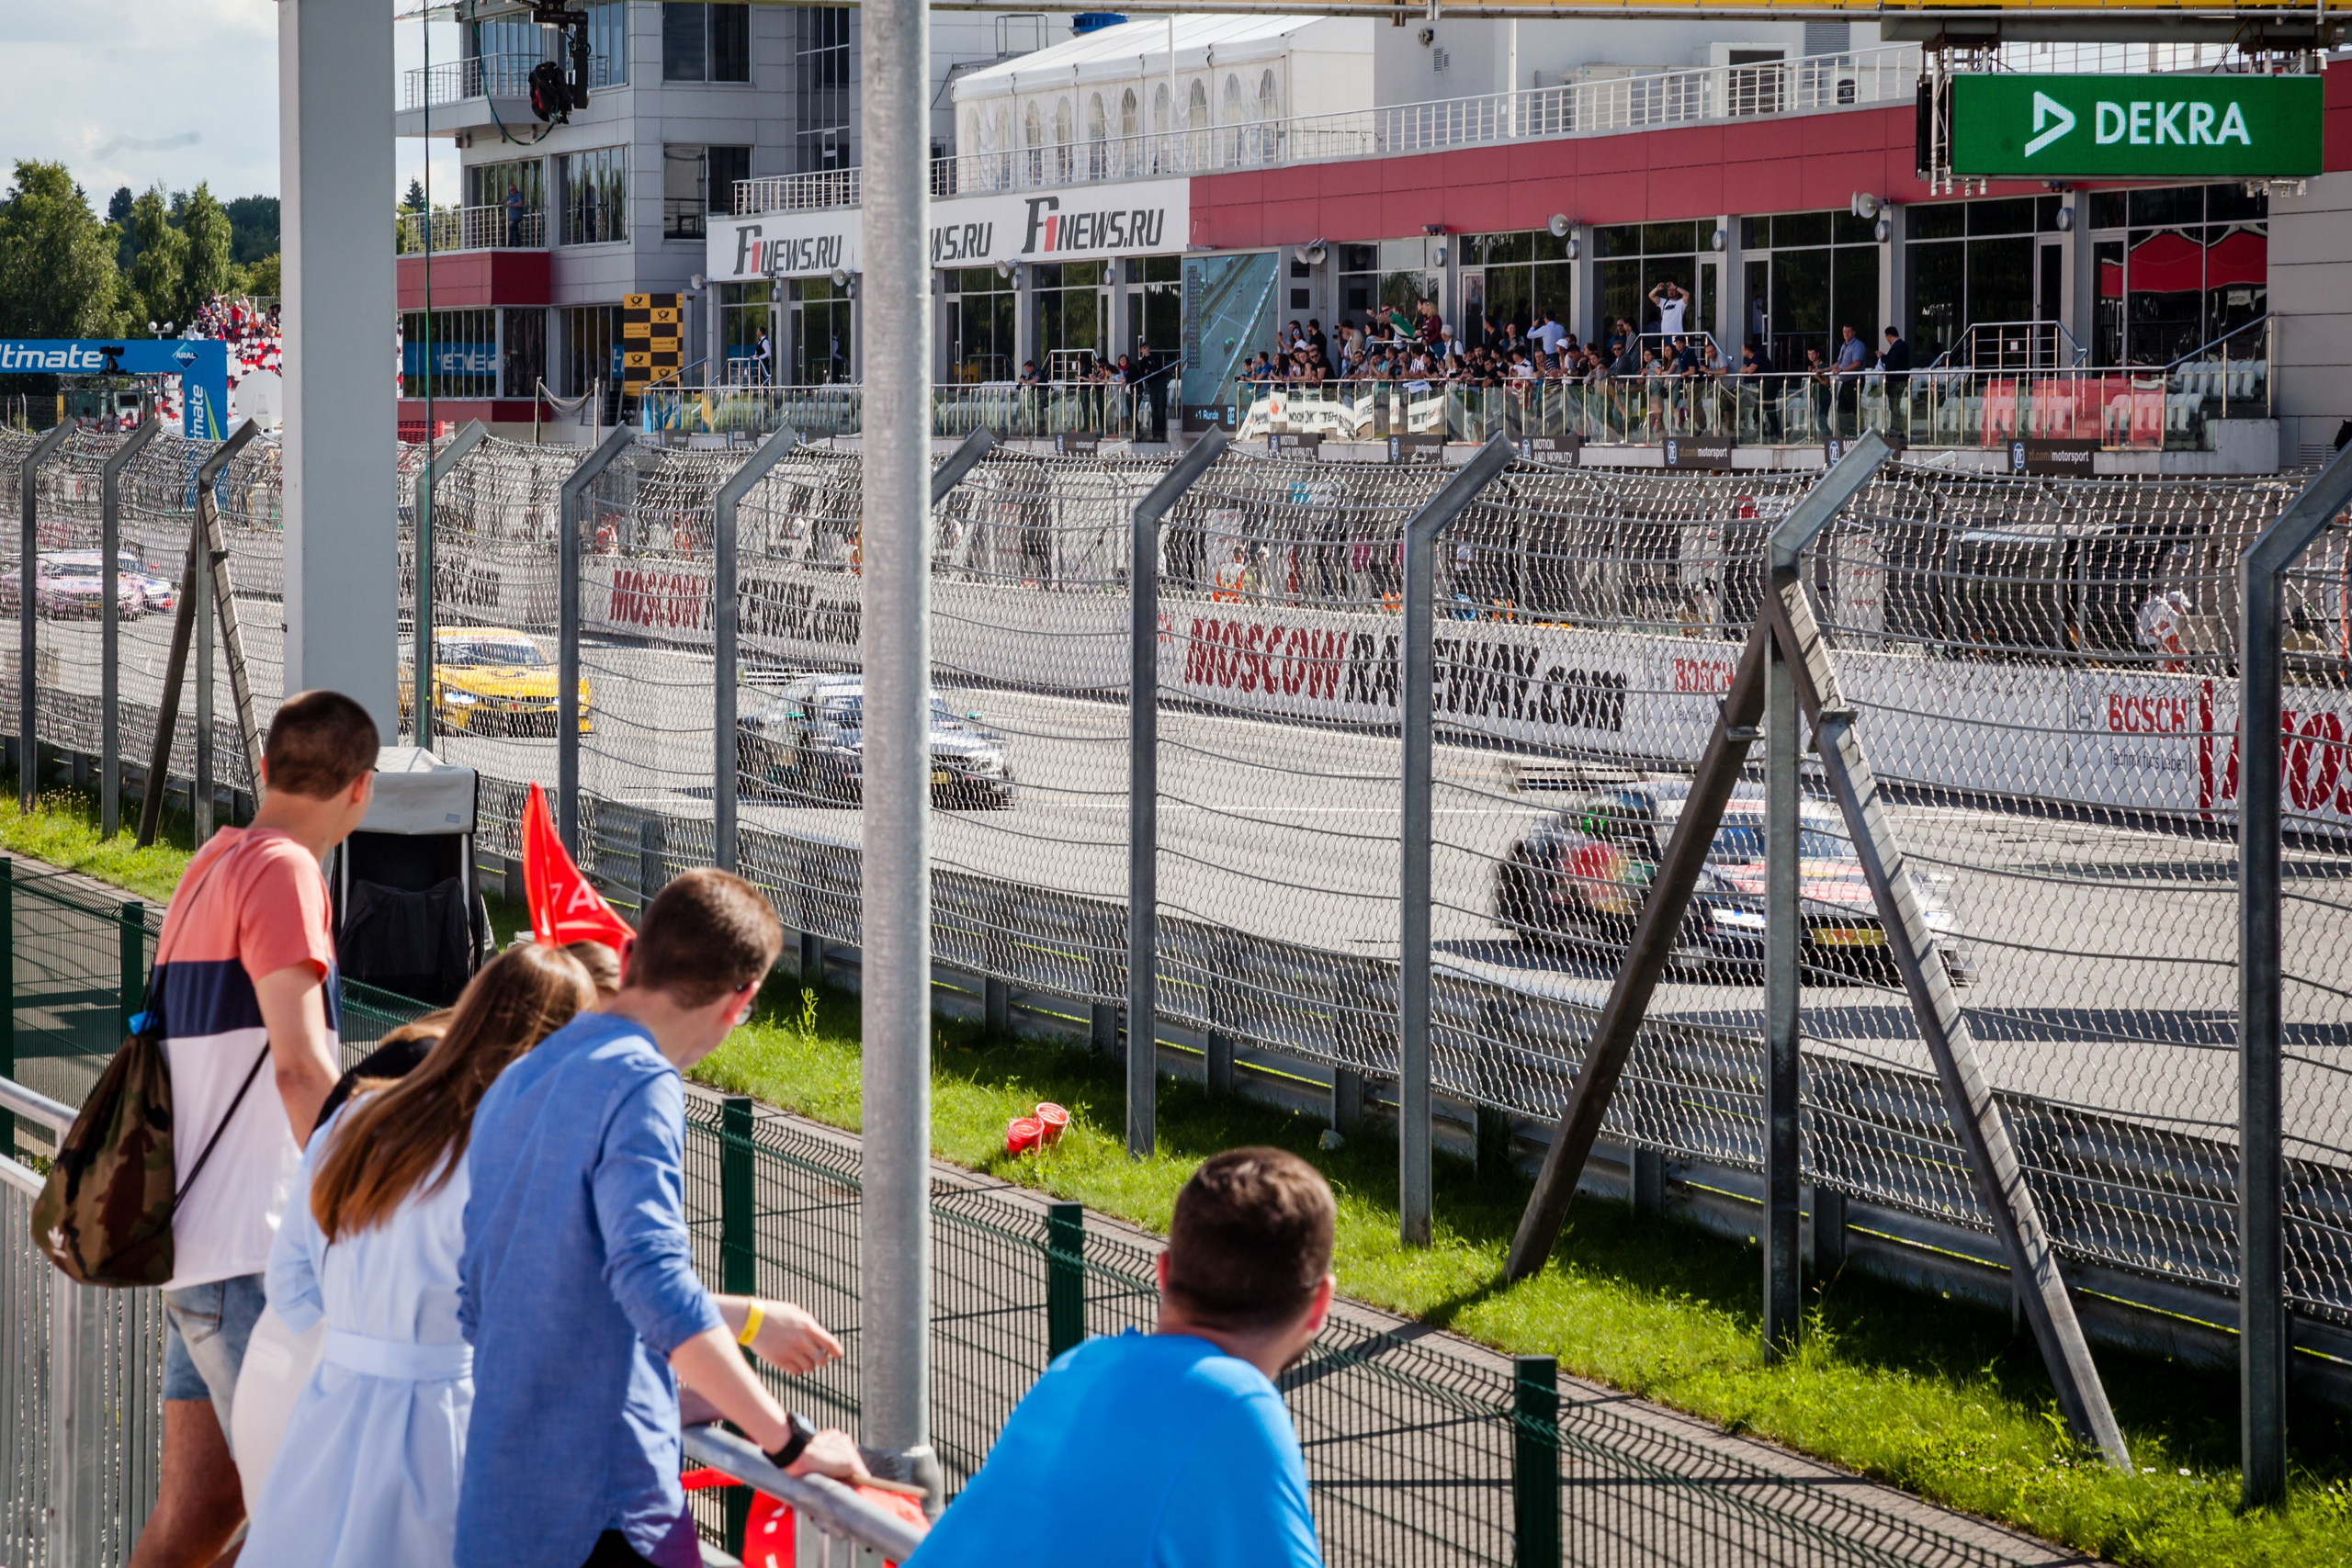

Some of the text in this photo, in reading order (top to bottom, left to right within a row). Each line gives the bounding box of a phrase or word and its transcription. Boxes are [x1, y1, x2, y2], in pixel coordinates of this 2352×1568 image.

[2096, 101, 2251, 145] DEKRA
[931, 221, 993, 262] WS.RU
[1021, 196, 1165, 254] F1NEWS.RU
[733, 224, 842, 276] F1NEWS.RU
[0, 344, 104, 368] timate
[189, 384, 204, 440] imate
[1204, 410, 1219, 420] Runde
[1532, 438, 1555, 449] MOTION
[1534, 452, 1573, 463] AND MOBILITY
[1675, 658, 1734, 698] BOSCH
[2109, 693, 2187, 740] BOSCH
